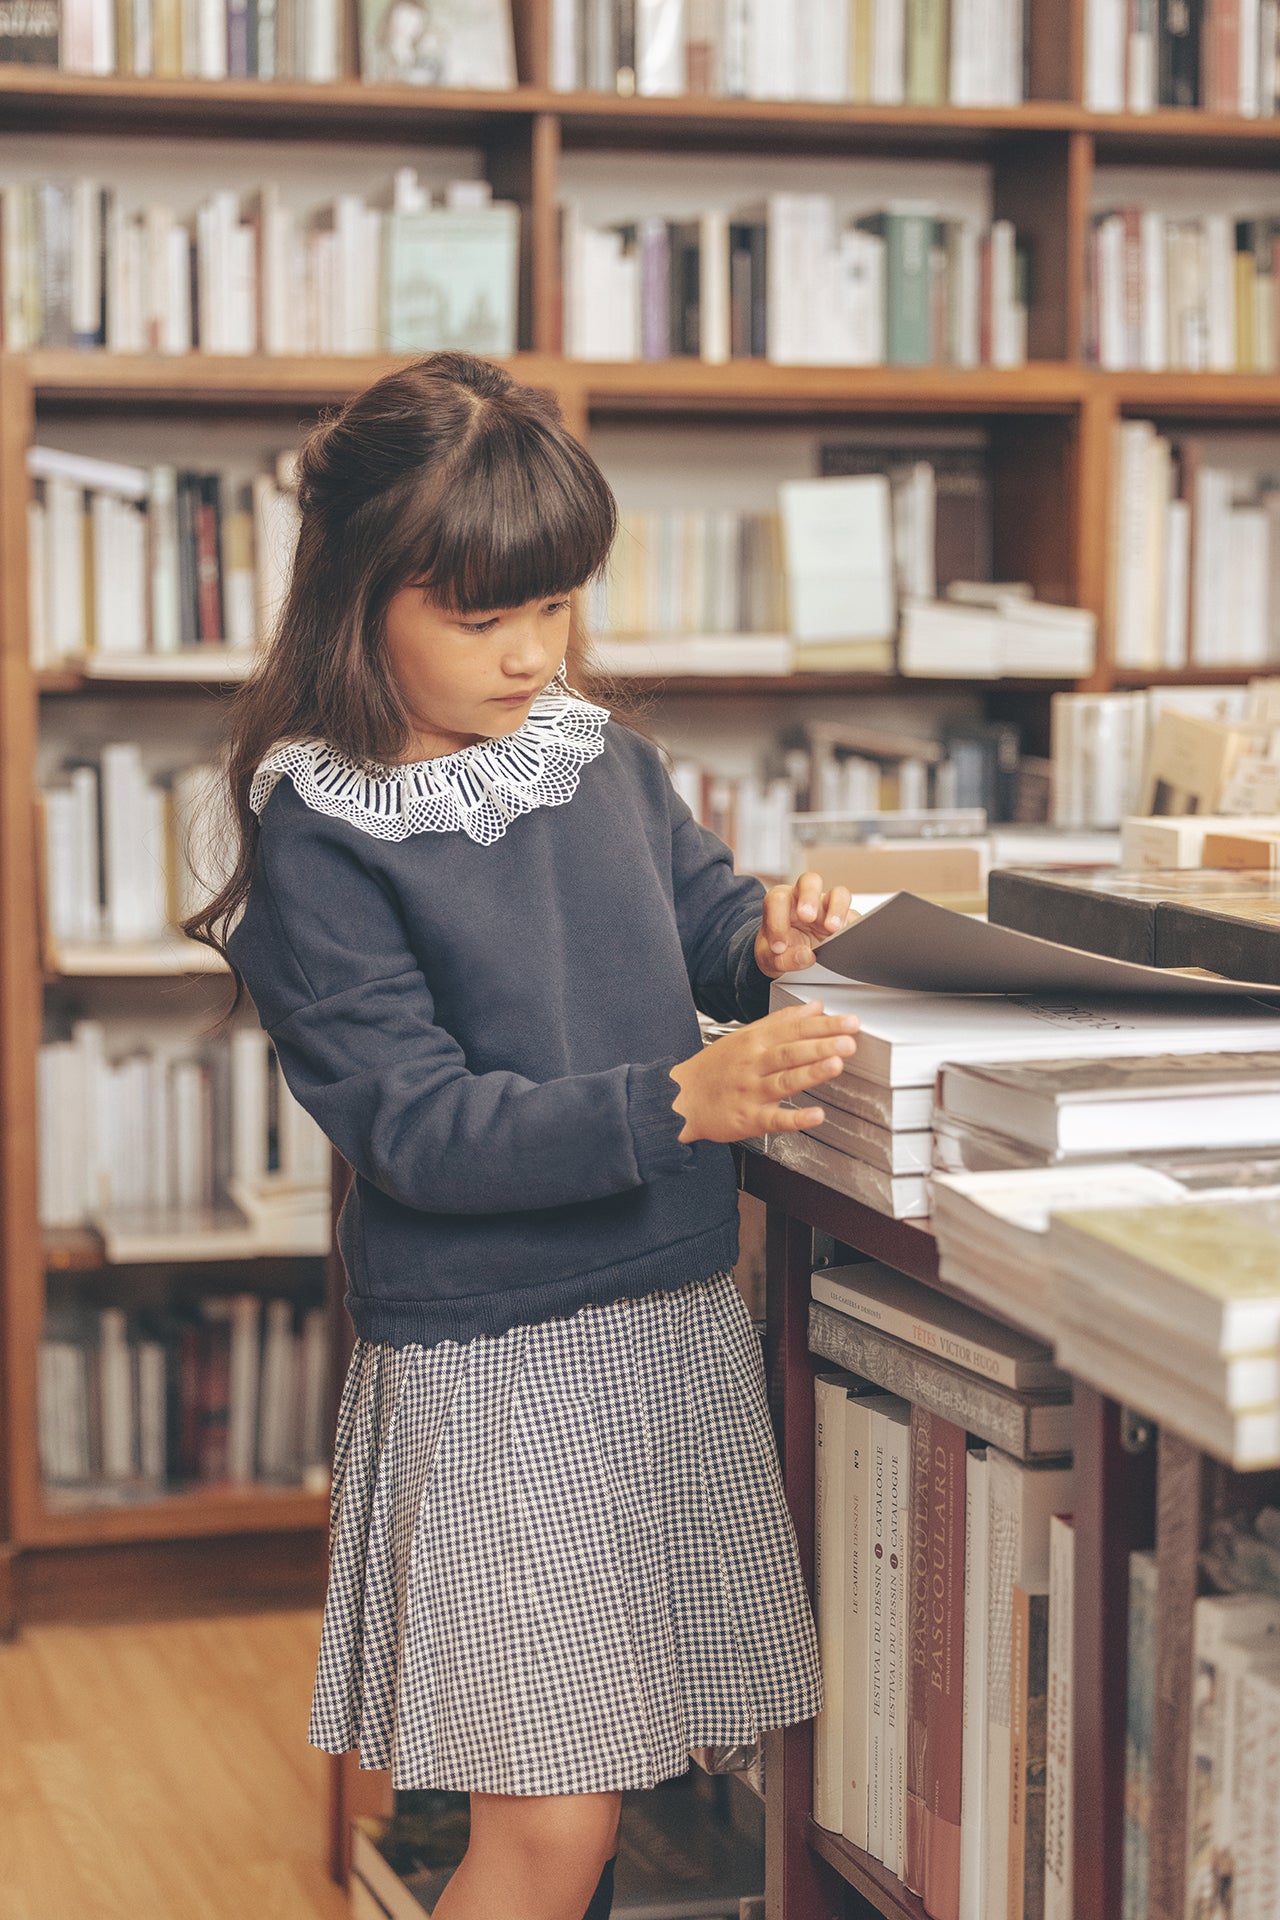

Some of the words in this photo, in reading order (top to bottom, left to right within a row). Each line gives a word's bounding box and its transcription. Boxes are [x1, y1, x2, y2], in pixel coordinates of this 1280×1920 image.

[940, 1337, 972, 1363] VICTOR
[973, 1351, 1000, 1376] HUGO
[874, 1445, 884, 1539] CATALOGUE
[890, 1454, 899, 1548] CATALOGUE
[914, 1426, 929, 1667] BASCOULARD
[931, 1445, 946, 1691] BASCOULARD
[853, 1599, 859, 1615] LE
[873, 1564, 882, 1617] DESSIN
[889, 1574, 897, 1628] DESSIN
[873, 1621, 882, 1644] DU
[888, 1631, 897, 1655] DU
[873, 1649, 882, 1717] FESTIVAL
[888, 1660, 896, 1729] FESTIVAL
